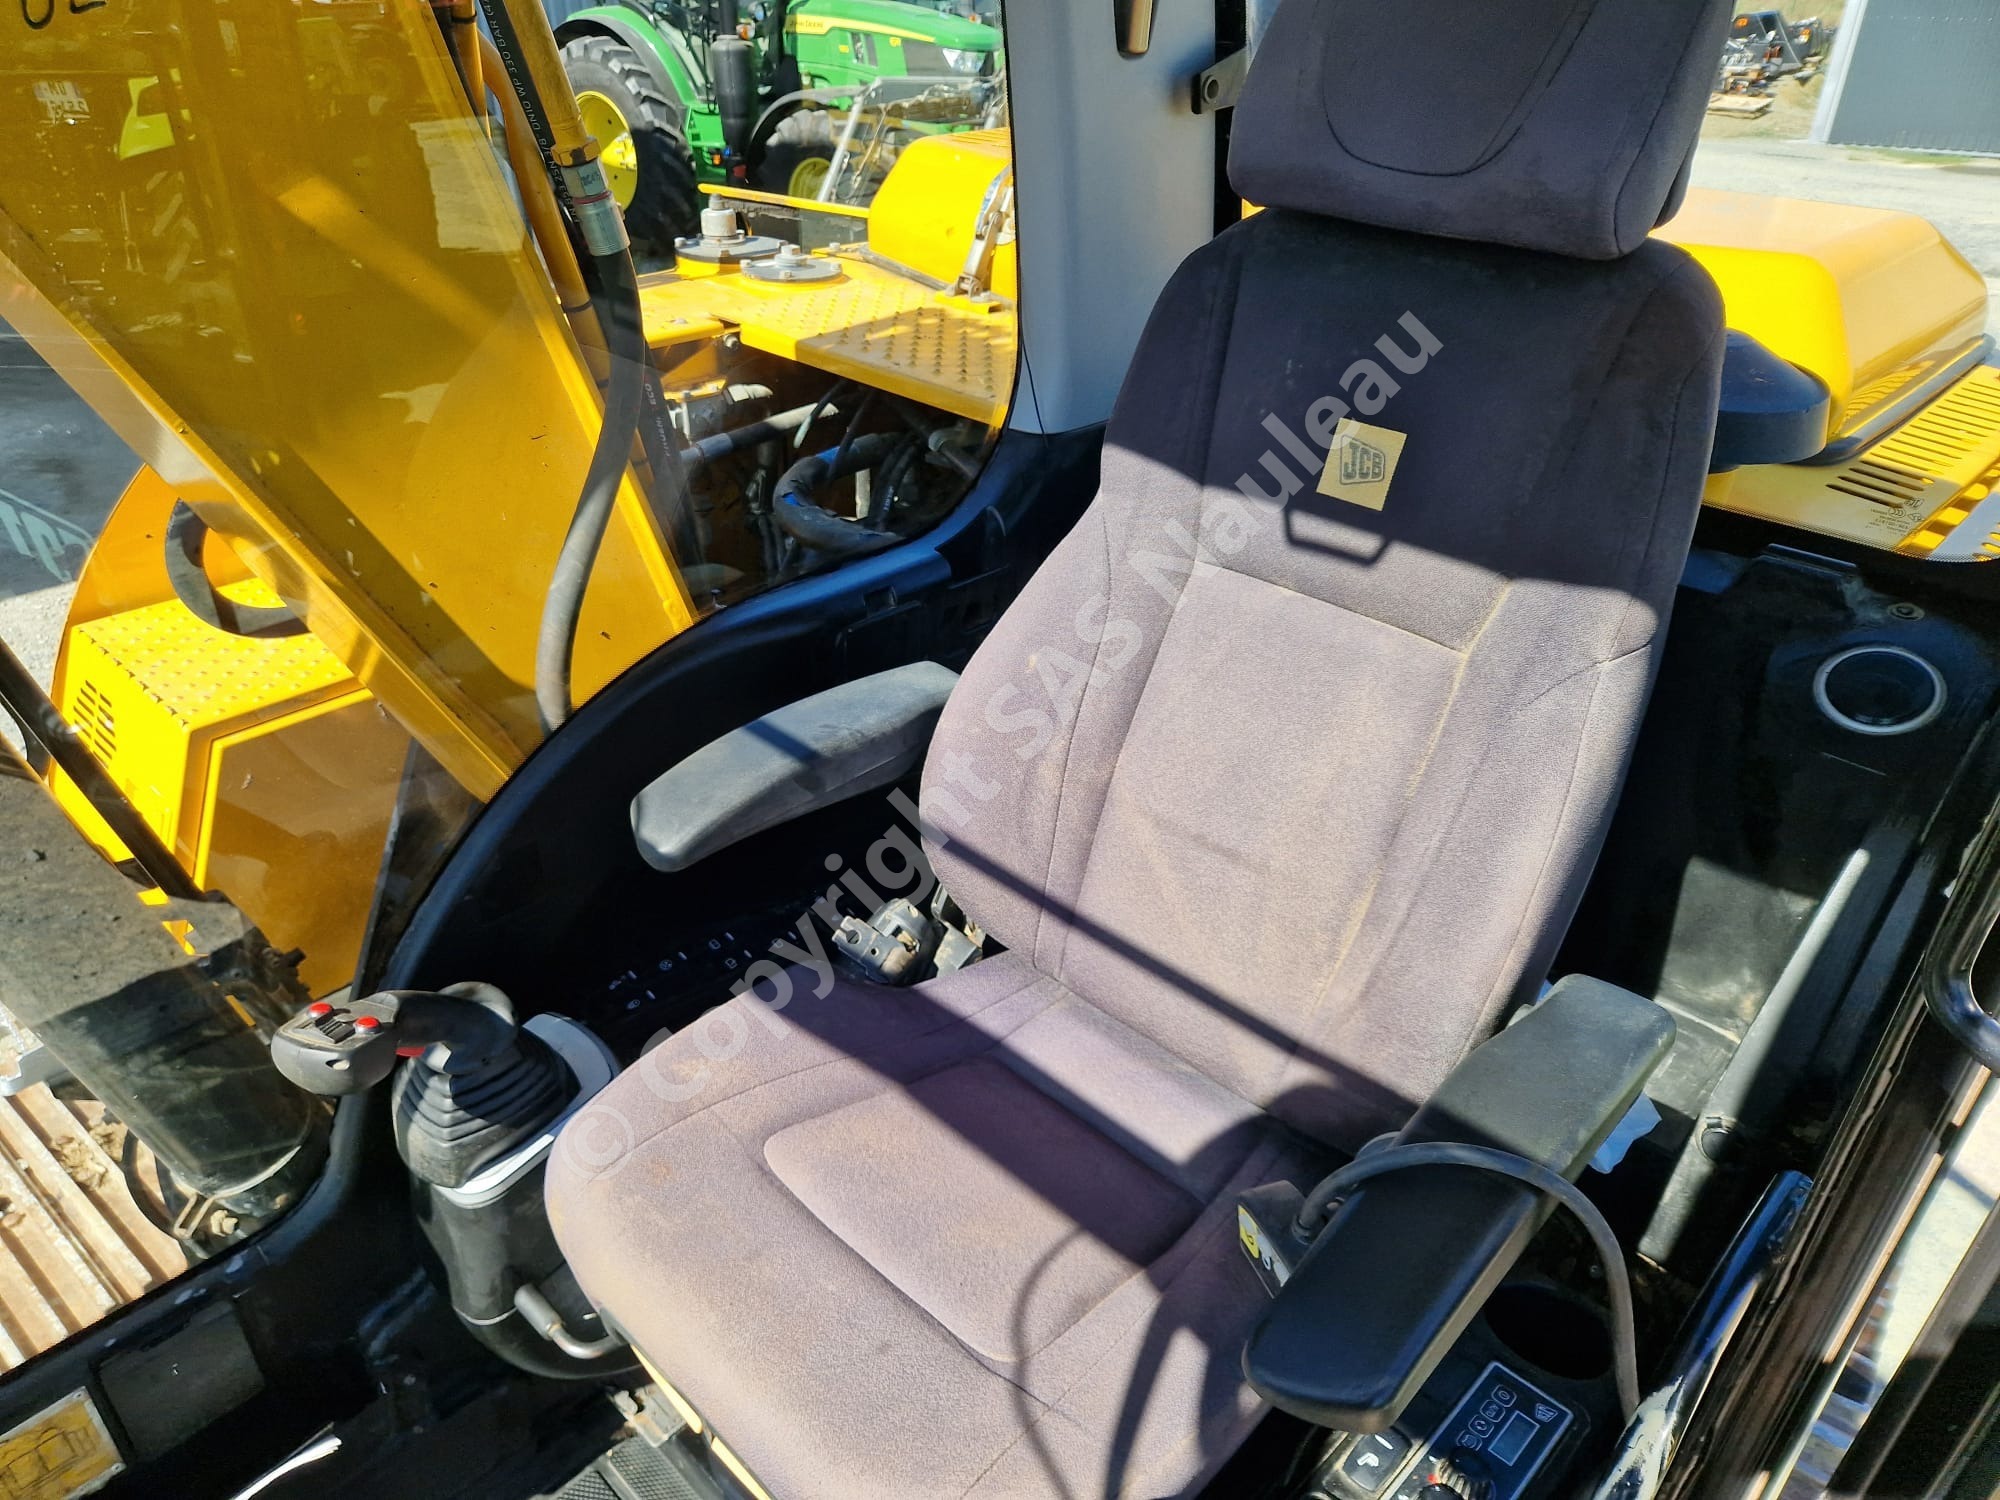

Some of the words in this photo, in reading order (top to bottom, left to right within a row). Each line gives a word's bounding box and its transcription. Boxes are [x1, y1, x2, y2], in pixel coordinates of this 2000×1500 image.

[489, 20, 506, 47] BAR
[503, 51, 518, 74] 330
[513, 78, 526, 97] WP
[1343, 440, 1383, 481] JCB
